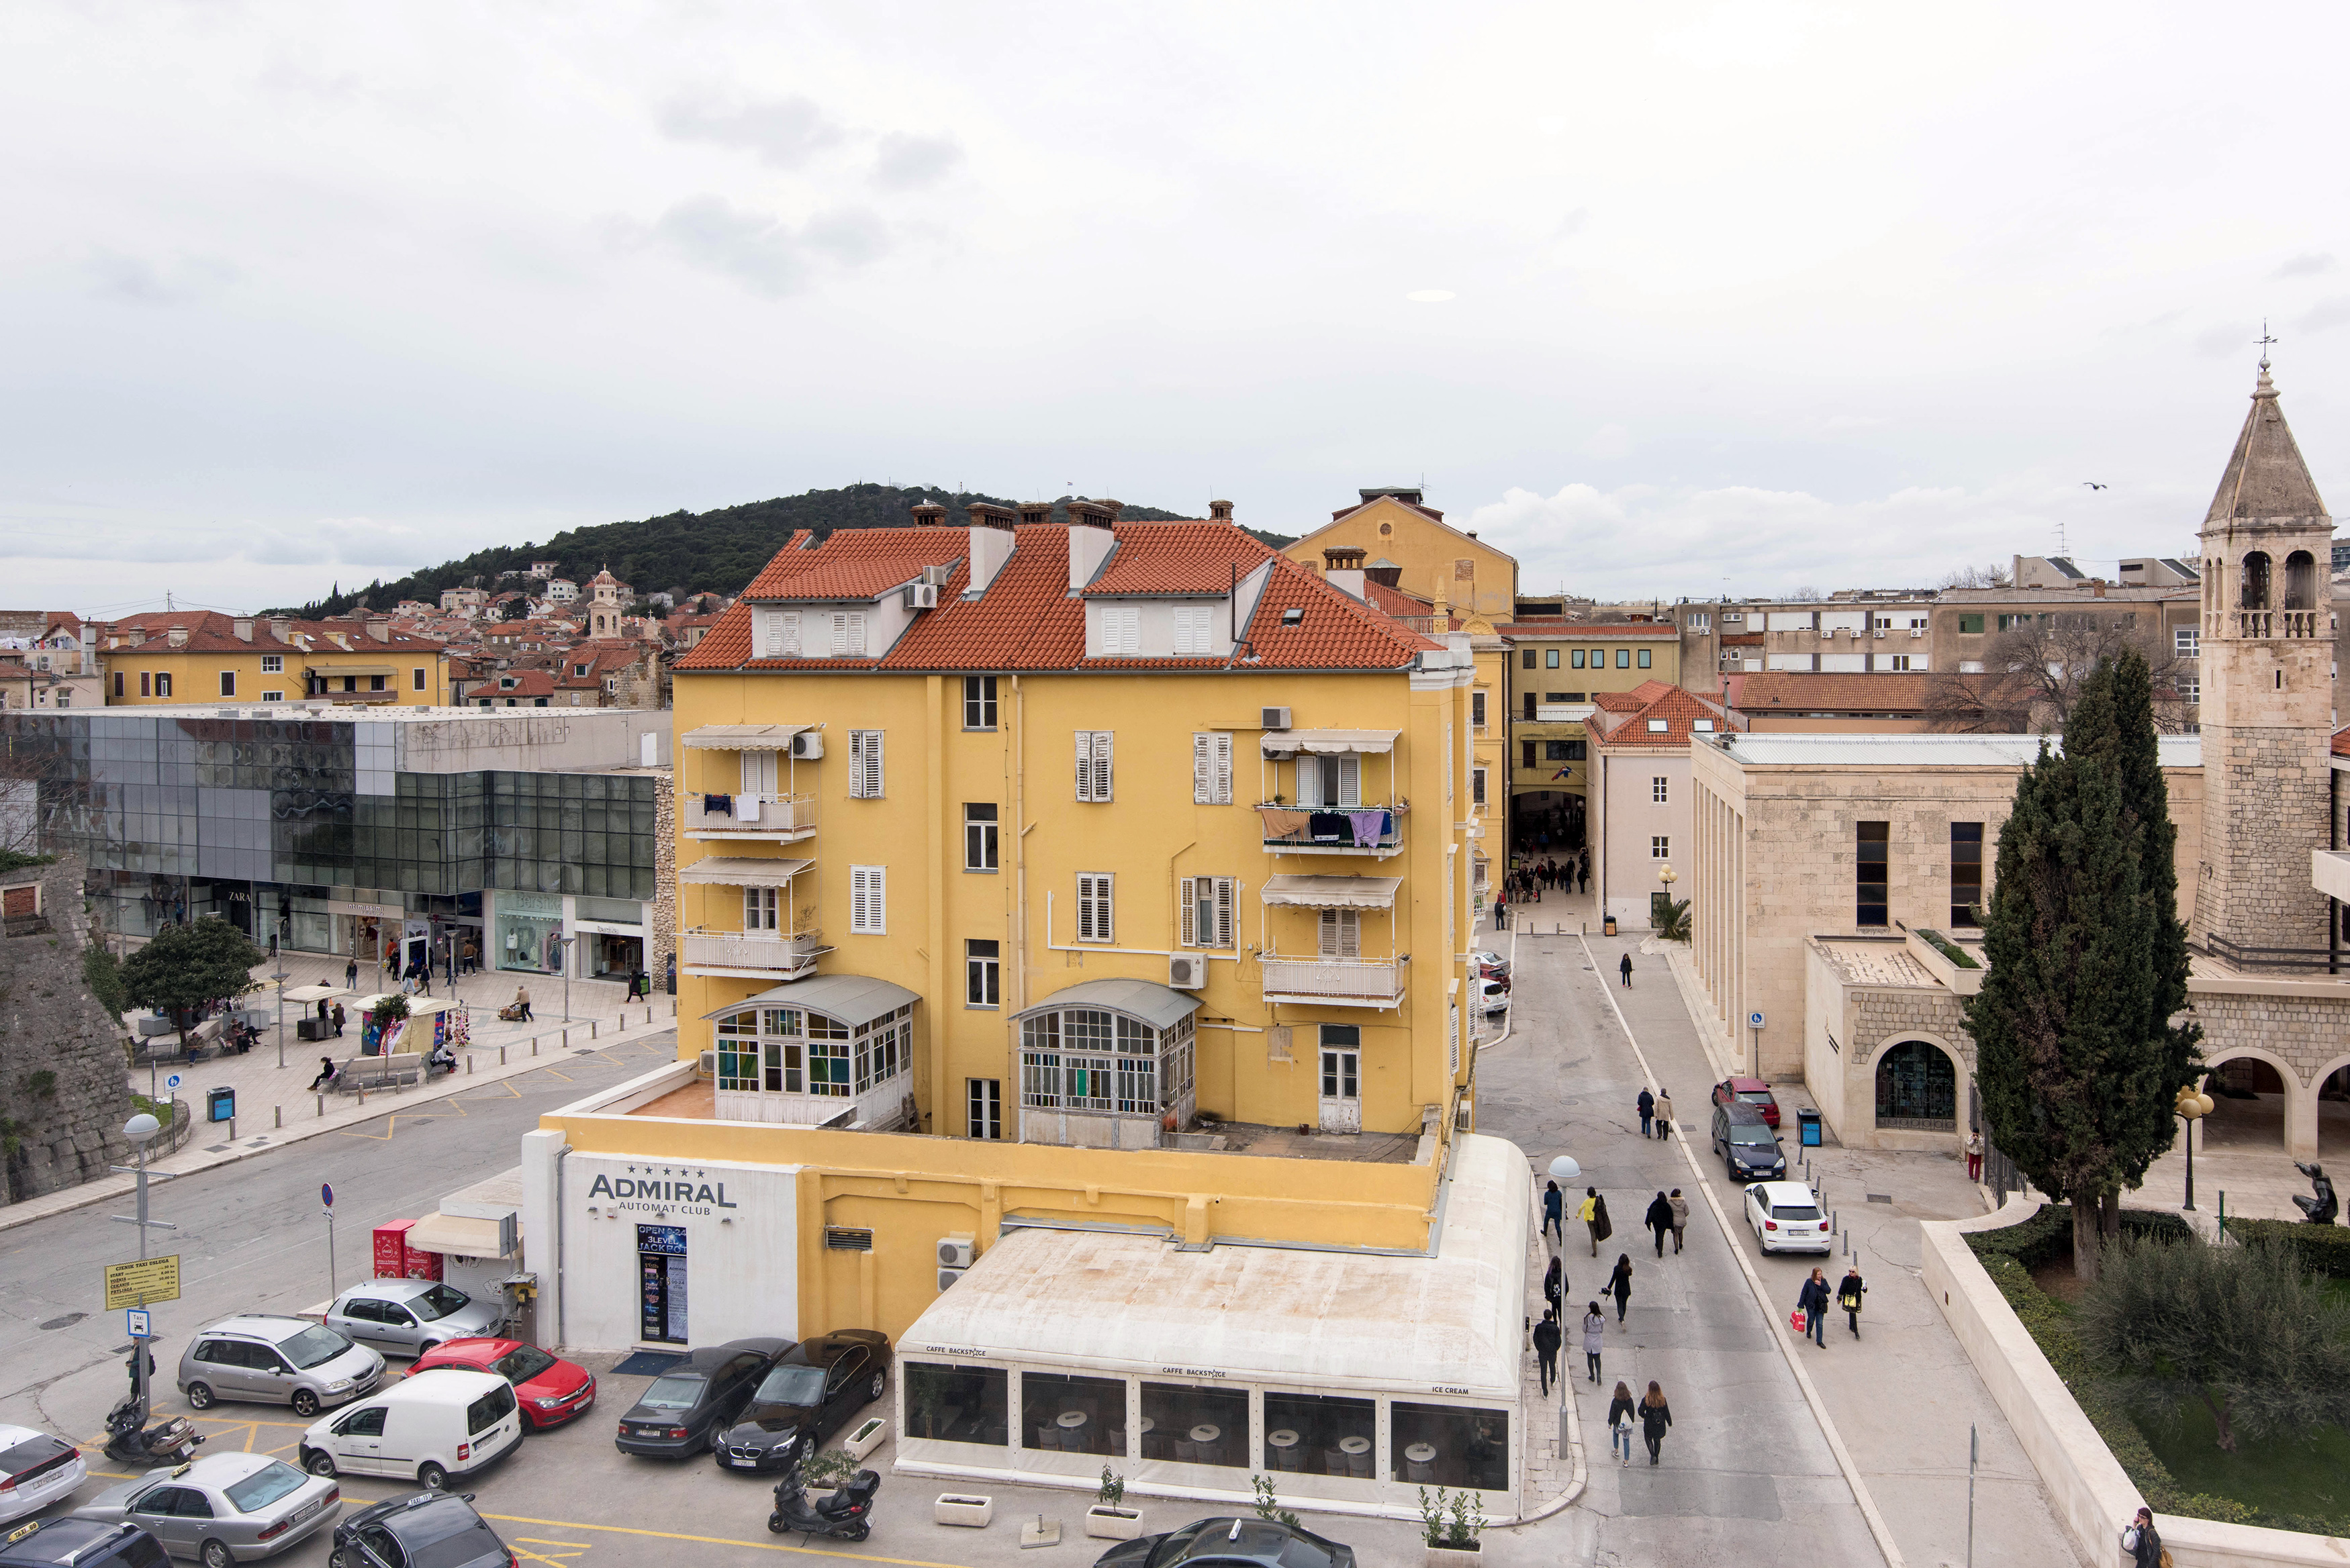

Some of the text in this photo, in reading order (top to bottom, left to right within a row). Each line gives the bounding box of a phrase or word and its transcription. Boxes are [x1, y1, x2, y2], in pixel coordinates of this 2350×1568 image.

[229, 891, 251, 902] ZARA
[516, 891, 563, 910] Bershka
[346, 903, 384, 912] intimissimi
[588, 1174, 737, 1208] ADMIRAL
[619, 1202, 710, 1216] AUTOMAT CLUB
[639, 1226, 687, 1236] OPEN 0-24
[648, 1236, 679, 1244] 3LEVEL
[638, 1242, 687, 1253] JACKPOT
[14, 1528, 27, 1538] TAXI
